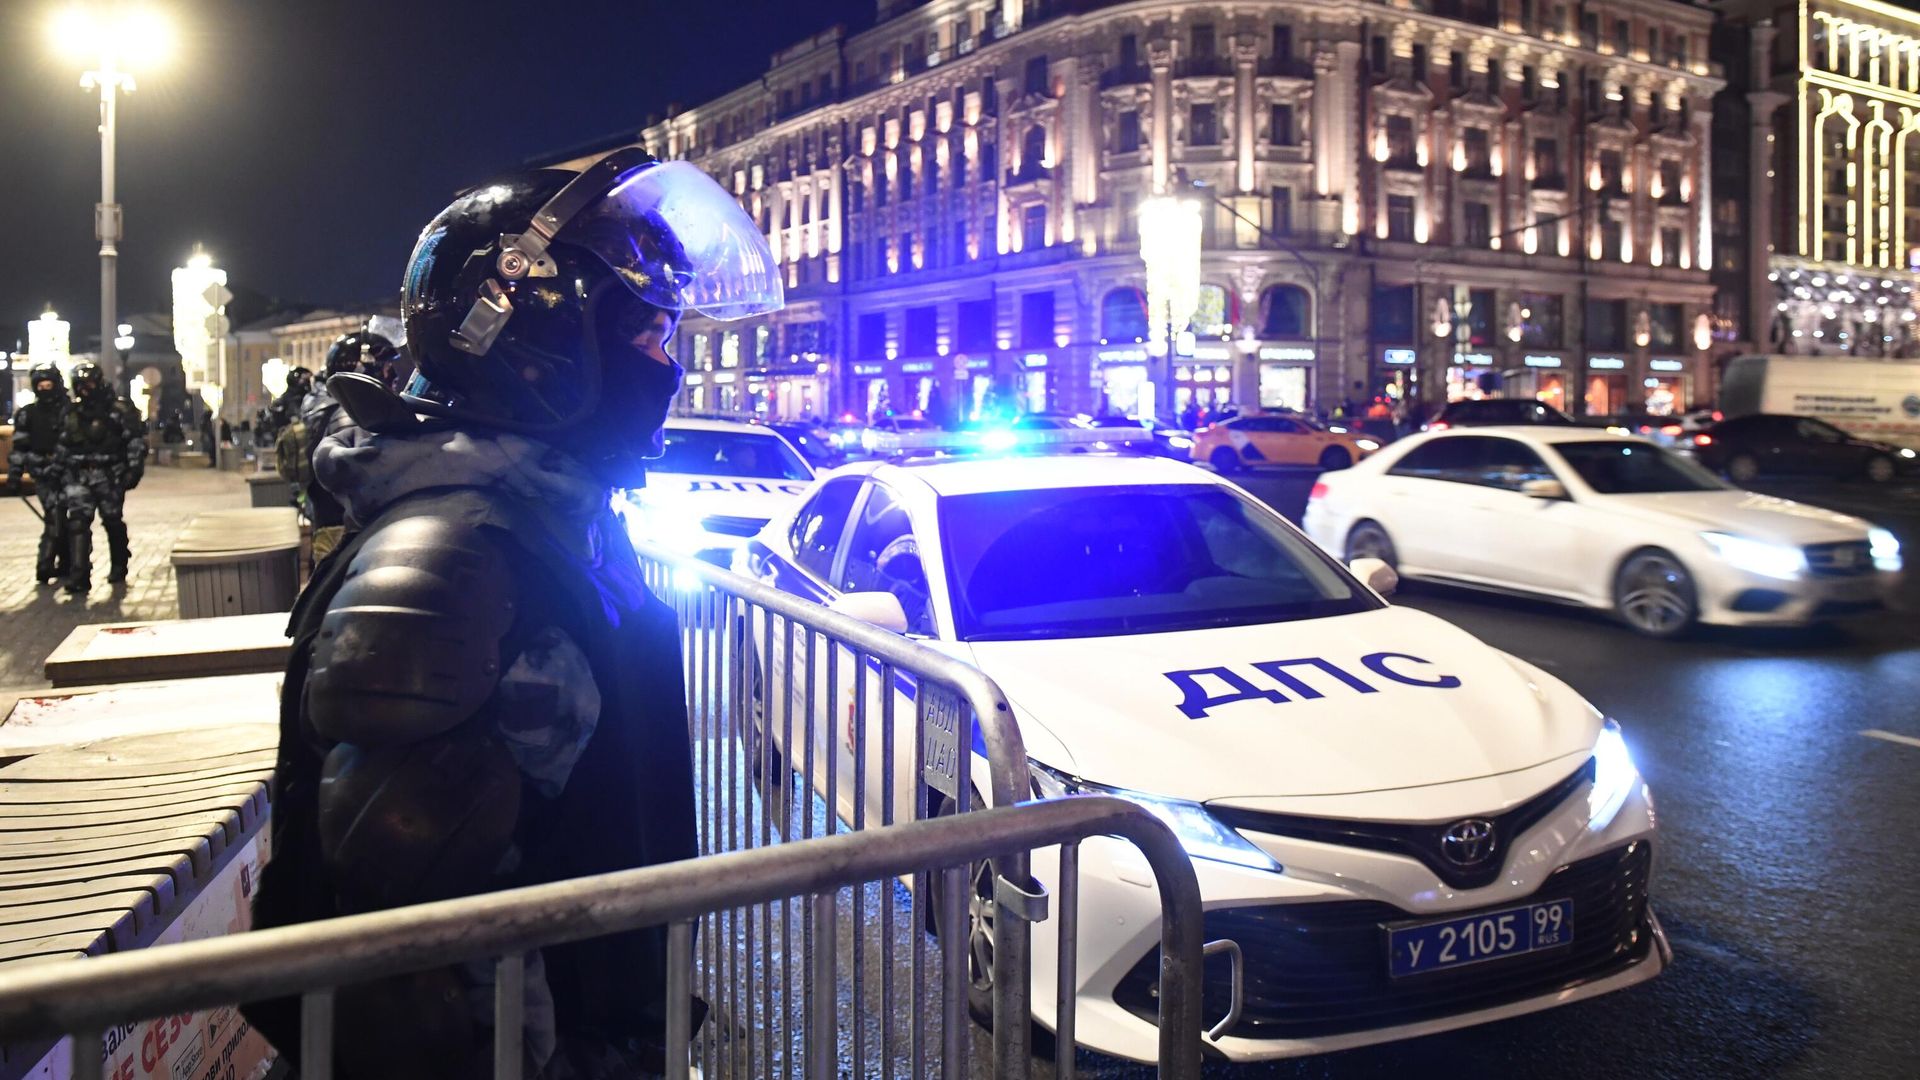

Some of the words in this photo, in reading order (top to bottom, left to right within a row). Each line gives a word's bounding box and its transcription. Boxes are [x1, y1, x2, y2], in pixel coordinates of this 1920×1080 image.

[687, 481, 806, 496] ДПС
[1162, 652, 1461, 720] ДПС
[1534, 905, 1563, 934] 99
[1439, 915, 1516, 962] 2105
[1538, 932, 1560, 944] RUS
[222, 1022, 249, 1065] прило
